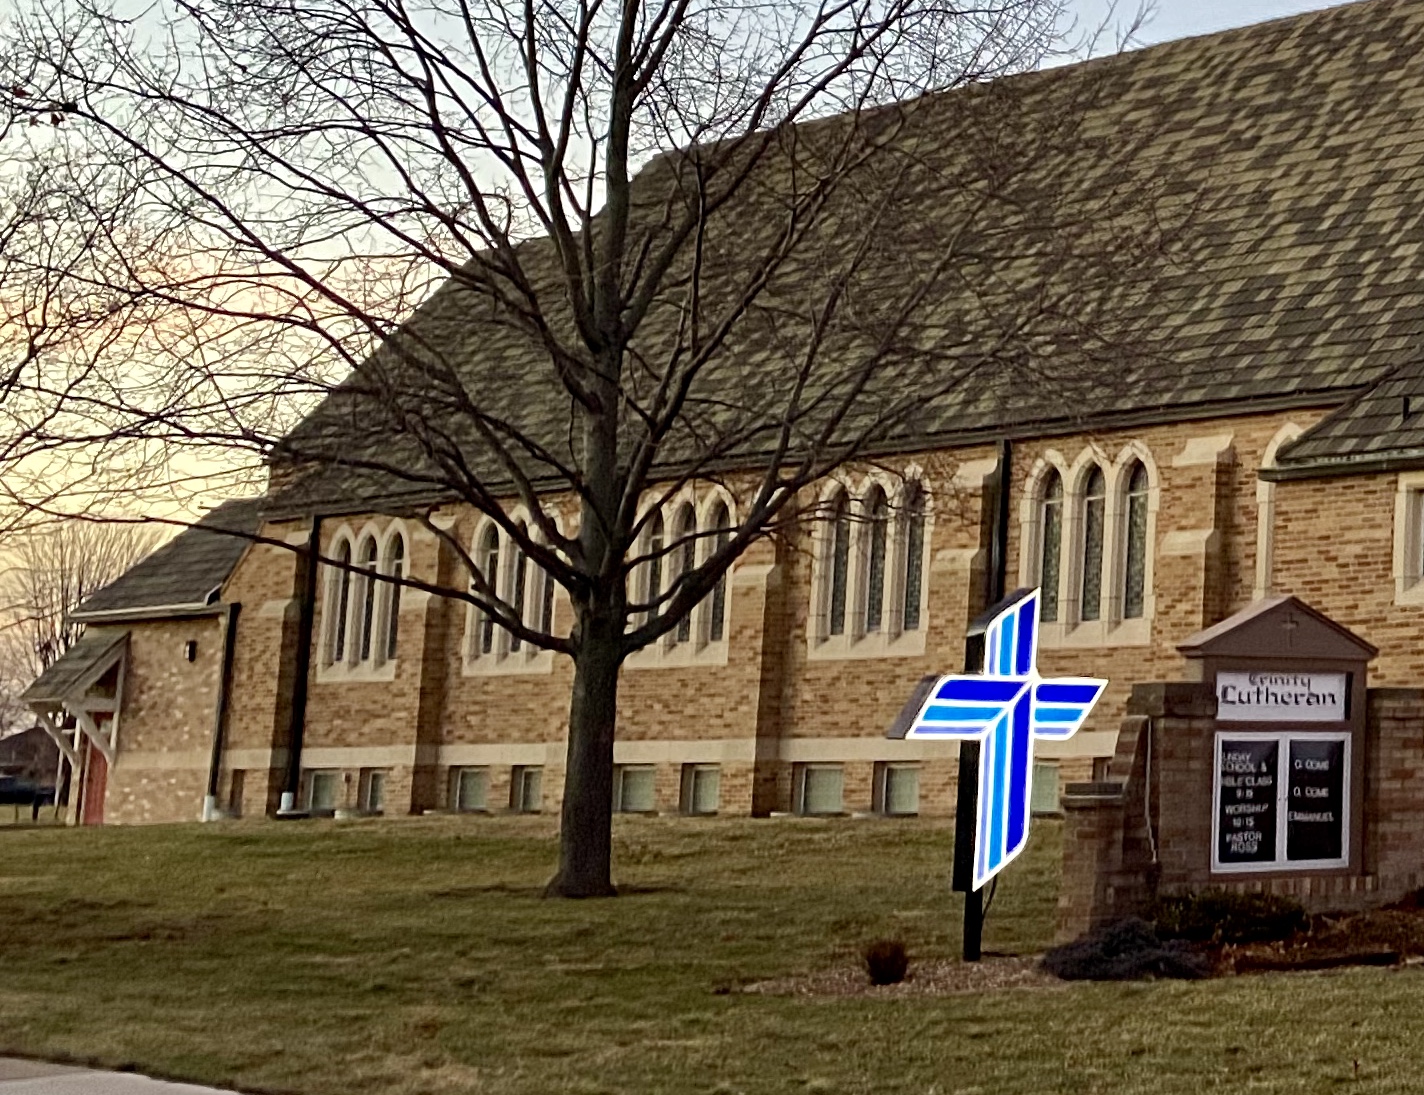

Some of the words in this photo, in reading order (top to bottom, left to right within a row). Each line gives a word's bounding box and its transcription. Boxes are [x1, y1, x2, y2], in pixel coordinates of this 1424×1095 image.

[1249, 673, 1311, 692] Trinity
[1221, 685, 1336, 706] Lutheran
[1305, 759, 1330, 771] COME
[1245, 775, 1273, 787] CLASS
[1305, 786, 1330, 798] COME
[1225, 803, 1269, 815] WORSHIP
[1225, 831, 1262, 843] PASTOR
[1231, 841, 1259, 854] ROSS
